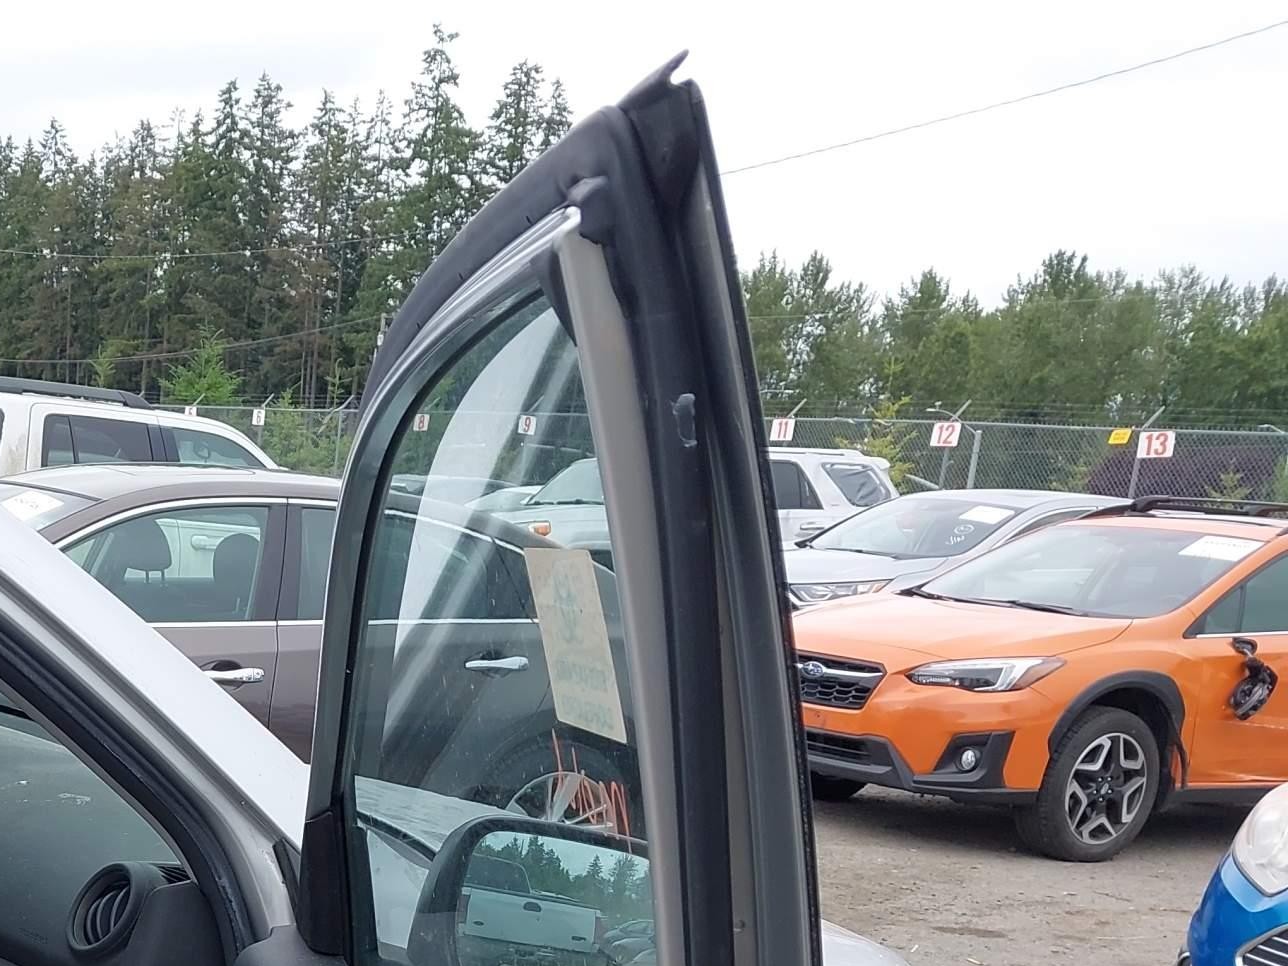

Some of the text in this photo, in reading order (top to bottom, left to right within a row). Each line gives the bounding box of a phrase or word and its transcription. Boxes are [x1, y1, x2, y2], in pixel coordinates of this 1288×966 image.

[417, 414, 425, 430] 8
[523, 416, 532, 433] 9
[777, 420, 789, 439] 11
[937, 423, 956, 445] 12
[1144, 432, 1169, 456] 13
